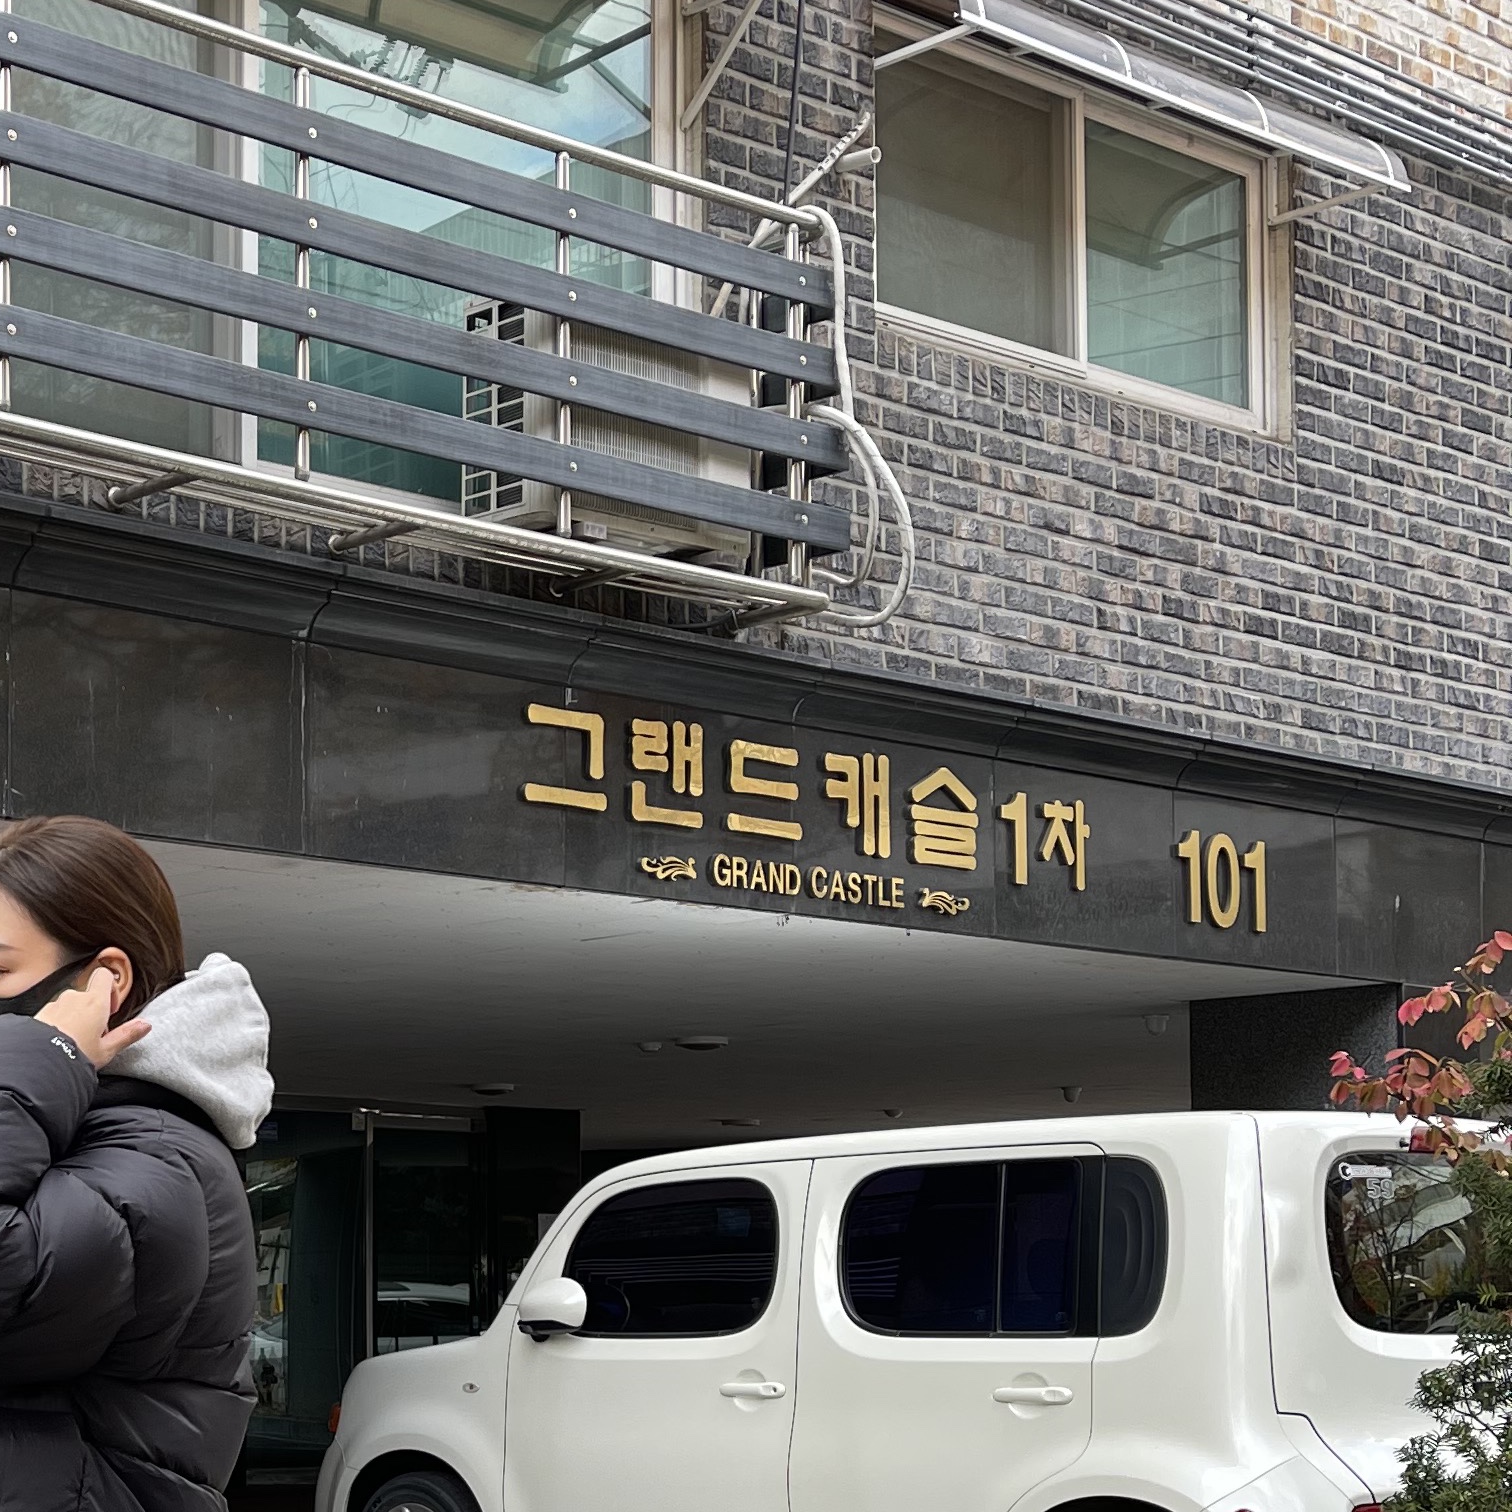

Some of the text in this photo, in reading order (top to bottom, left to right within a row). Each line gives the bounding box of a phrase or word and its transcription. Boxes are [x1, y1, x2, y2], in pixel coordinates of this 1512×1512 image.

[712, 853, 905, 909] GRAND CASTLE
[1176, 829, 1268, 934] 101
[1366, 1178, 1395, 1200] 59
